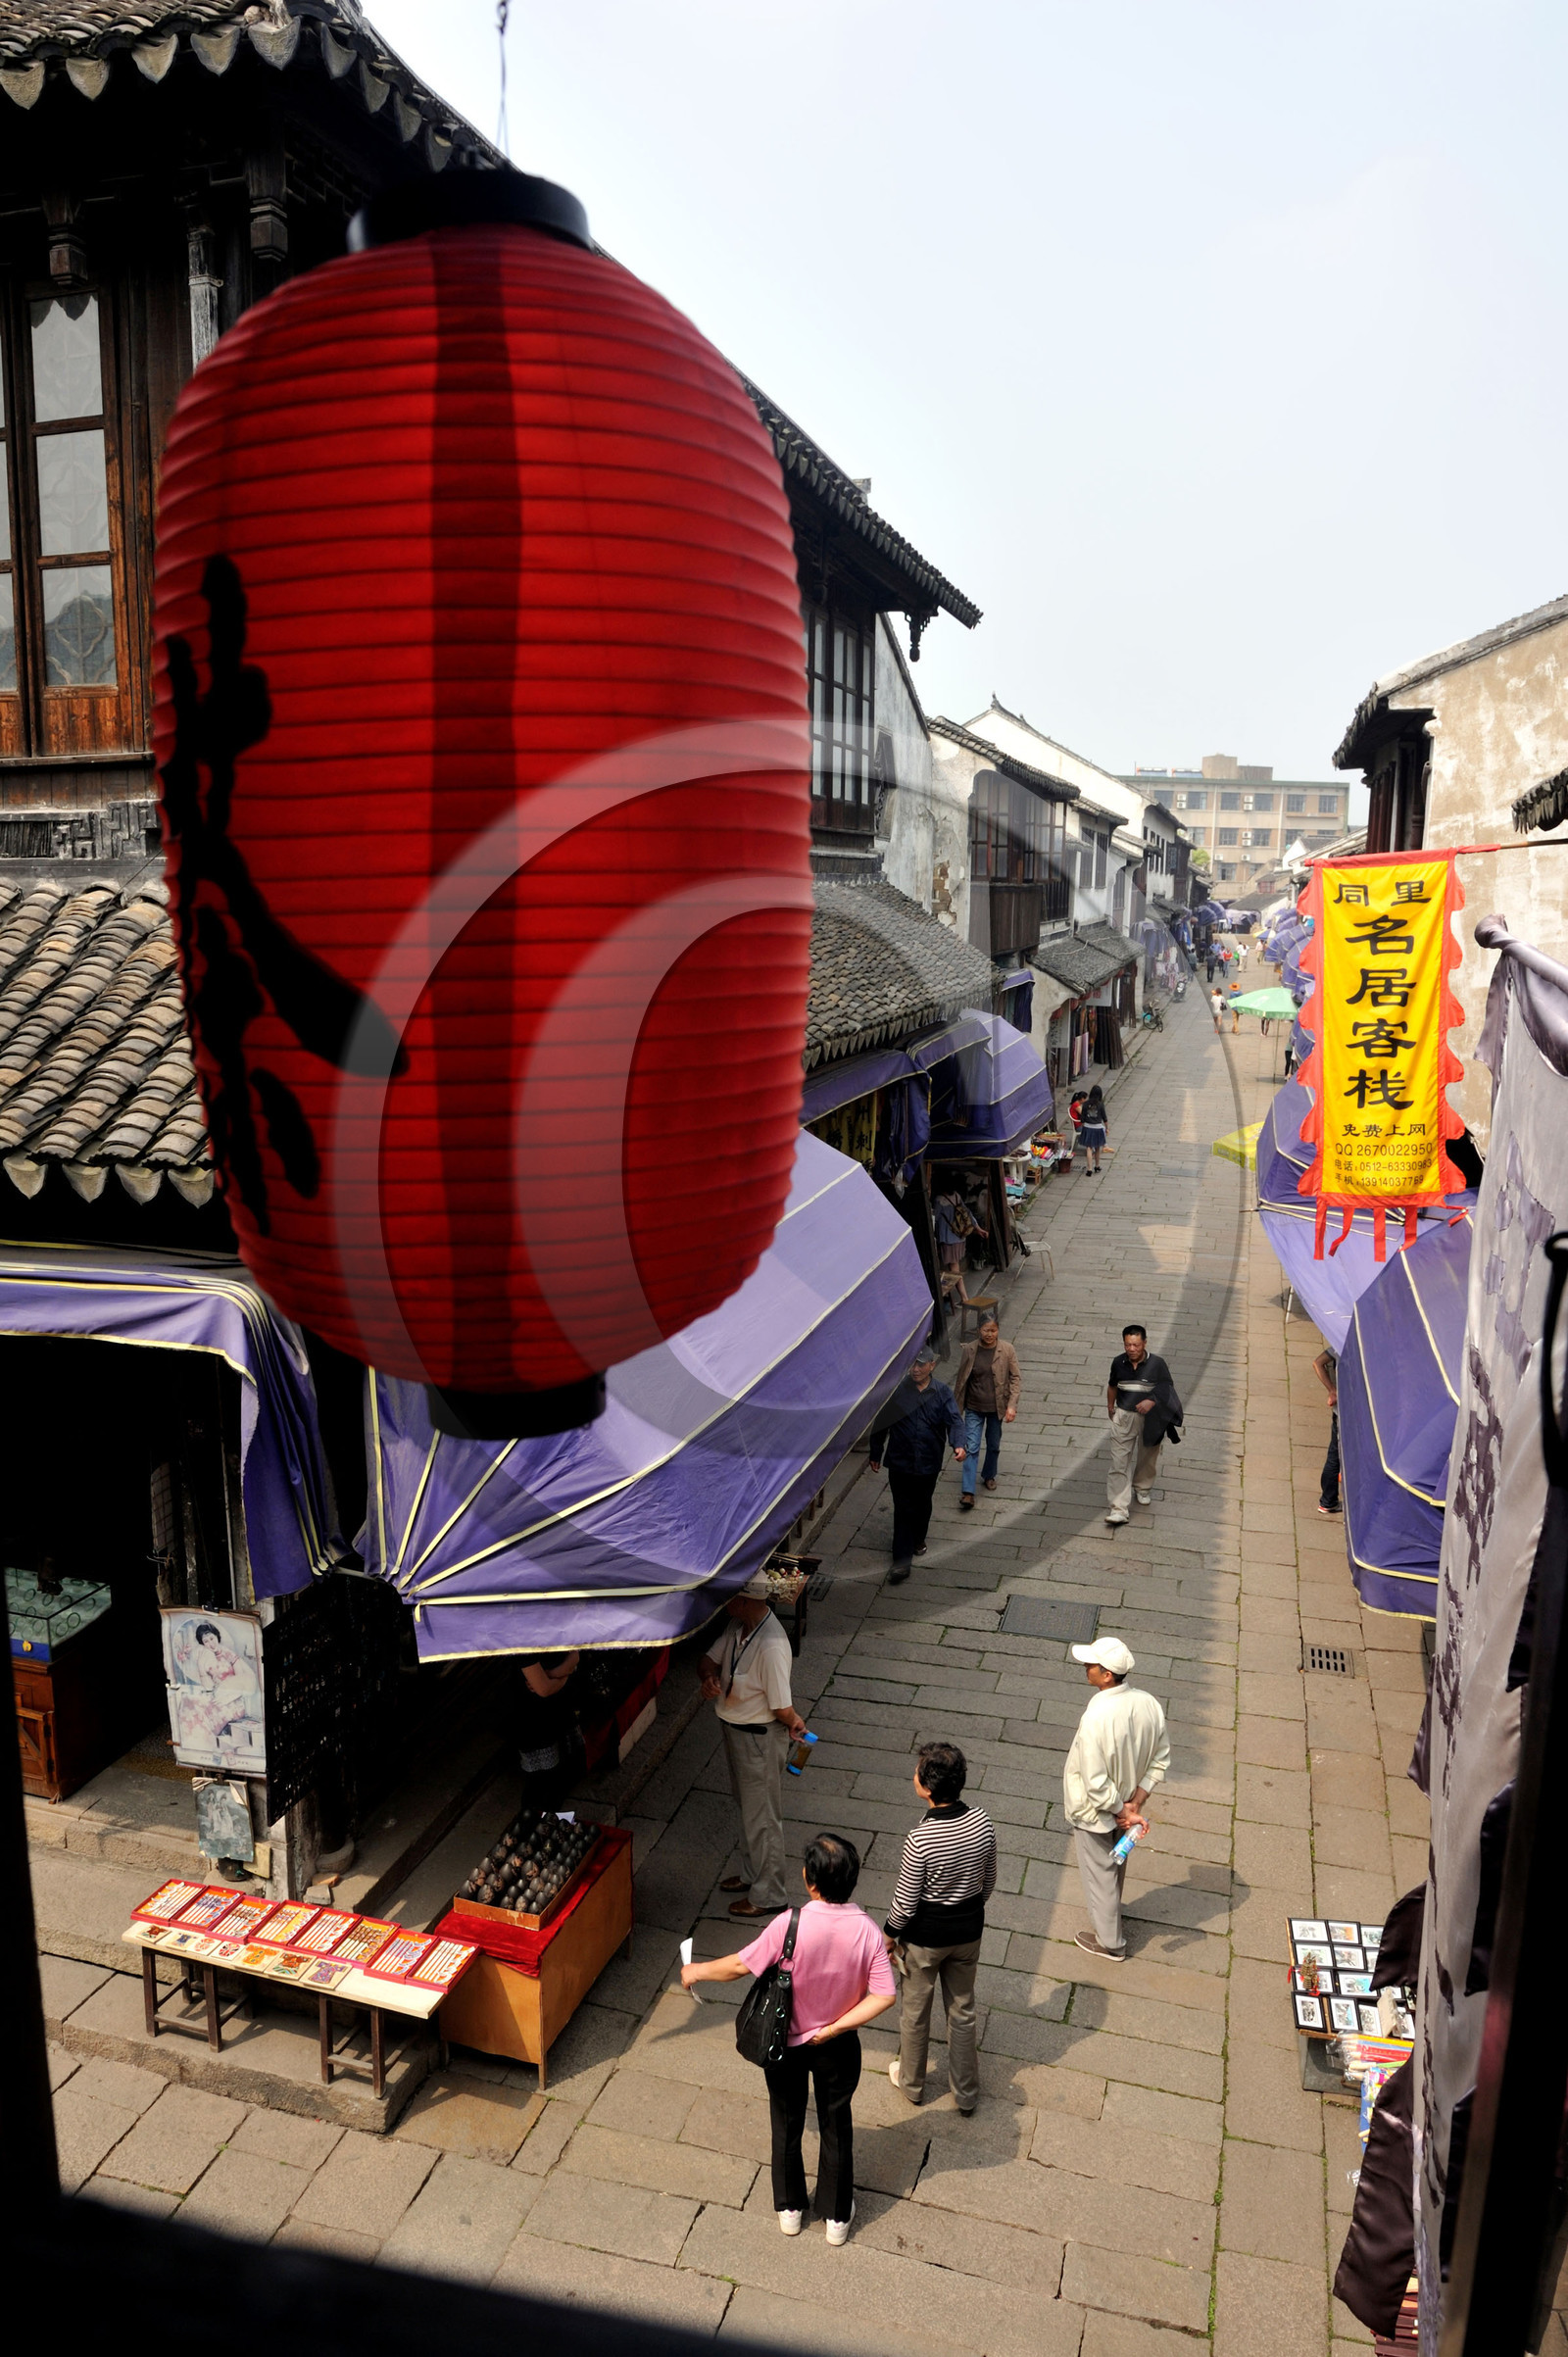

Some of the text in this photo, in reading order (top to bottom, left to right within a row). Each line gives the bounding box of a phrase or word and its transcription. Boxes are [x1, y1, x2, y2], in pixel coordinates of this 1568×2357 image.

[1333, 880, 1432, 907] 同里
[1344, 915, 1416, 1109] 名居客栈
[1342, 1123, 1427, 1138] 免费上网
[1335, 1142, 1433, 1156] QQ 2670022950
